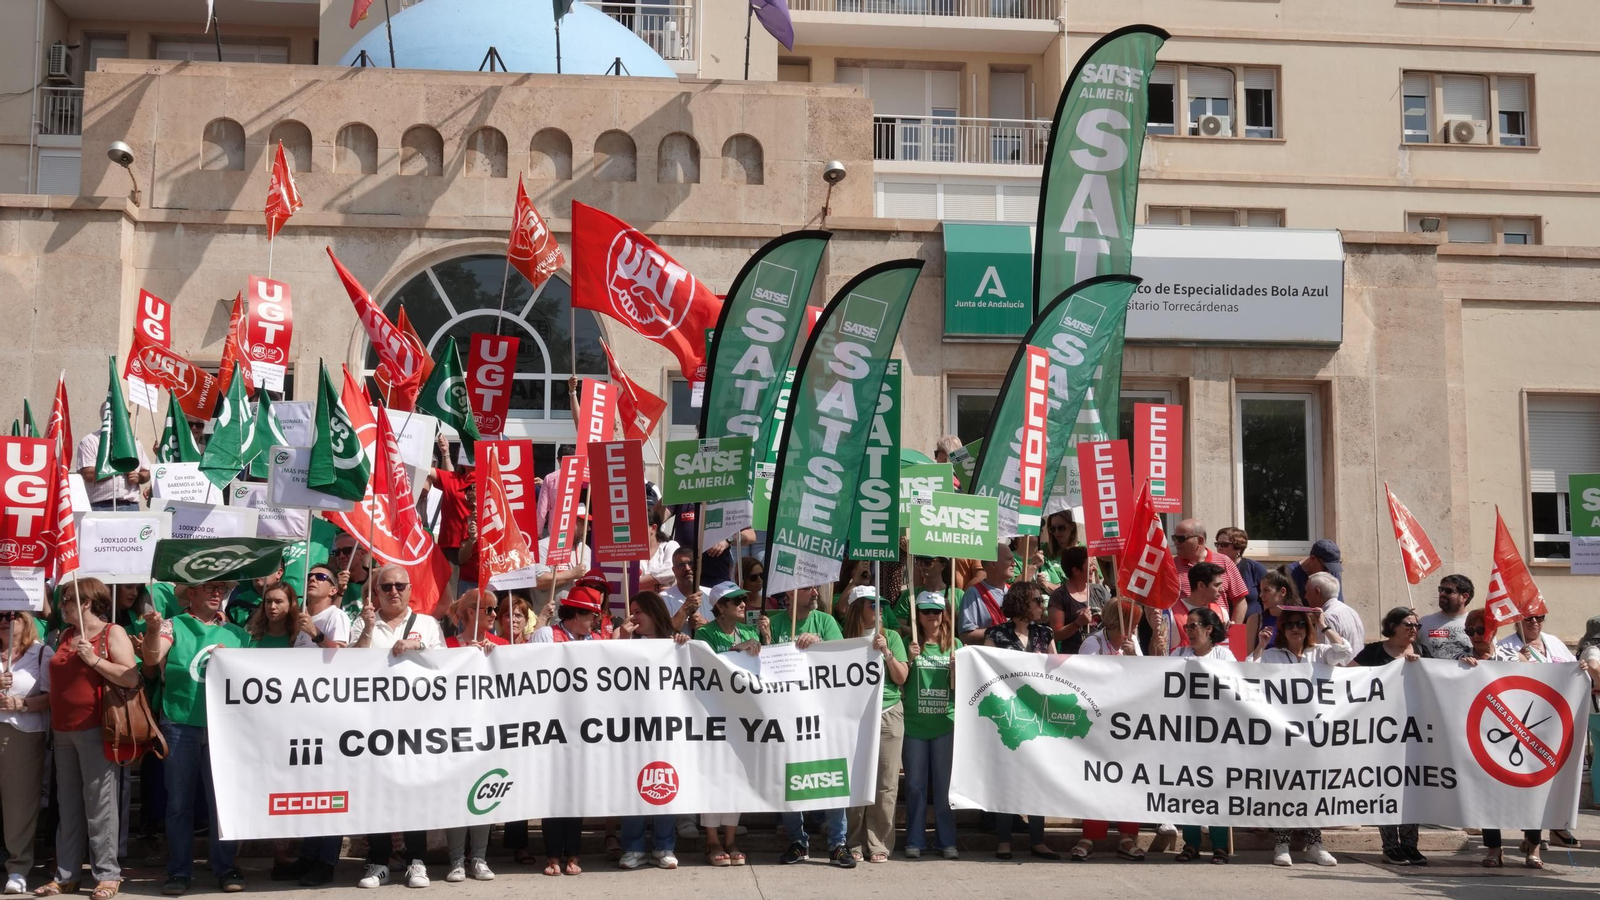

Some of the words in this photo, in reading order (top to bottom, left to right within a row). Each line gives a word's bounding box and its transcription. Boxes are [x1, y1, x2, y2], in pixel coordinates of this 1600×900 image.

[1081, 63, 1144, 90] SATSE
[1079, 88, 1135, 104] ALMERÍA
[617, 236, 688, 308] UGT
[754, 287, 789, 305] SATSE
[955, 300, 976, 308] Junta
[977, 300, 987, 308] de
[988, 300, 1024, 309] Andalucía
[1155, 283, 1170, 295] de
[1173, 283, 1268, 298] Especialidades
[1271, 285, 1299, 297] Bola
[1302, 286, 1329, 297] Azul
[142, 295, 165, 341] UG
[257, 280, 285, 345] UGT
[1162, 301, 1239, 313] Torrecárdenas
[843, 320, 878, 340] SATSE
[1062, 316, 1094, 335] SATSE
[145, 351, 190, 391] UGT
[475, 339, 509, 412] UGT
[726, 307, 787, 442] SATS
[798, 341, 872, 536] SATSE
[1024, 353, 1047, 502] CCOO
[1150, 406, 1167, 479] CCOO
[673, 449, 744, 476] SATSE
[859, 382, 894, 544] SATSE
[4, 442, 48, 538] UGT
[560, 458, 579, 531] CCOO
[605, 443, 630, 523] CCOO
[677, 473, 736, 491] ALMERÍA
[1093, 443, 1119, 519] CCOO
[178, 525, 205, 533] 100X100
[919, 505, 990, 532] SATSE
[776, 527, 845, 560] ALMERÍA
[852, 548, 895, 558] ALMERÍA
[925, 530, 984, 546] ALMERÍA
[225, 677, 283, 705] LOS
[290, 675, 448, 704] ACUERDOS
[455, 667, 588, 701] FIRMADOS
[596, 666, 650, 691] SON
[659, 666, 724, 692] PARA
[920, 688, 947, 697] SATSE
[968, 674, 1009, 706] COORDINADORA
[1010, 671, 1044, 680] ANDALUZA
[1045, 673, 1054, 681] DE
[1055, 676, 1081, 693] MAREAS
[1080, 690, 1103, 718] BLANCAS
[1163, 671, 1336, 706] DEFIENDE
[1346, 677, 1385, 703] LA
[1051, 712, 1076, 721] CAMB
[1110, 712, 1271, 746] SANIDAD
[1285, 713, 1434, 748] PÚBLICA:
[1486, 693, 1508, 718] MAREA
[1506, 715, 1531, 742] BLANCA
[1529, 740, 1557, 768] ALMERÍA
[288, 737, 324, 766] ¡¡¡
[339, 717, 568, 758] CONSEJERA
[580, 716, 727, 744] CUMPLE
[739, 717, 785, 743] YA
[795, 715, 821, 741] !!!
[642, 767, 675, 787] UGT
[789, 771, 845, 792] SATSE
[1084, 760, 1124, 784] NO
[1132, 763, 1150, 785] A
[1159, 764, 1214, 788] LAS
[1226, 765, 1457, 790] PRIVATIZACIONES
[273, 795, 331, 811] CCOO
[476, 781, 514, 800] CSIF
[1146, 792, 1219, 815] Marea
[1228, 795, 1308, 817] Blanca
[1314, 792, 1398, 817] Almería
